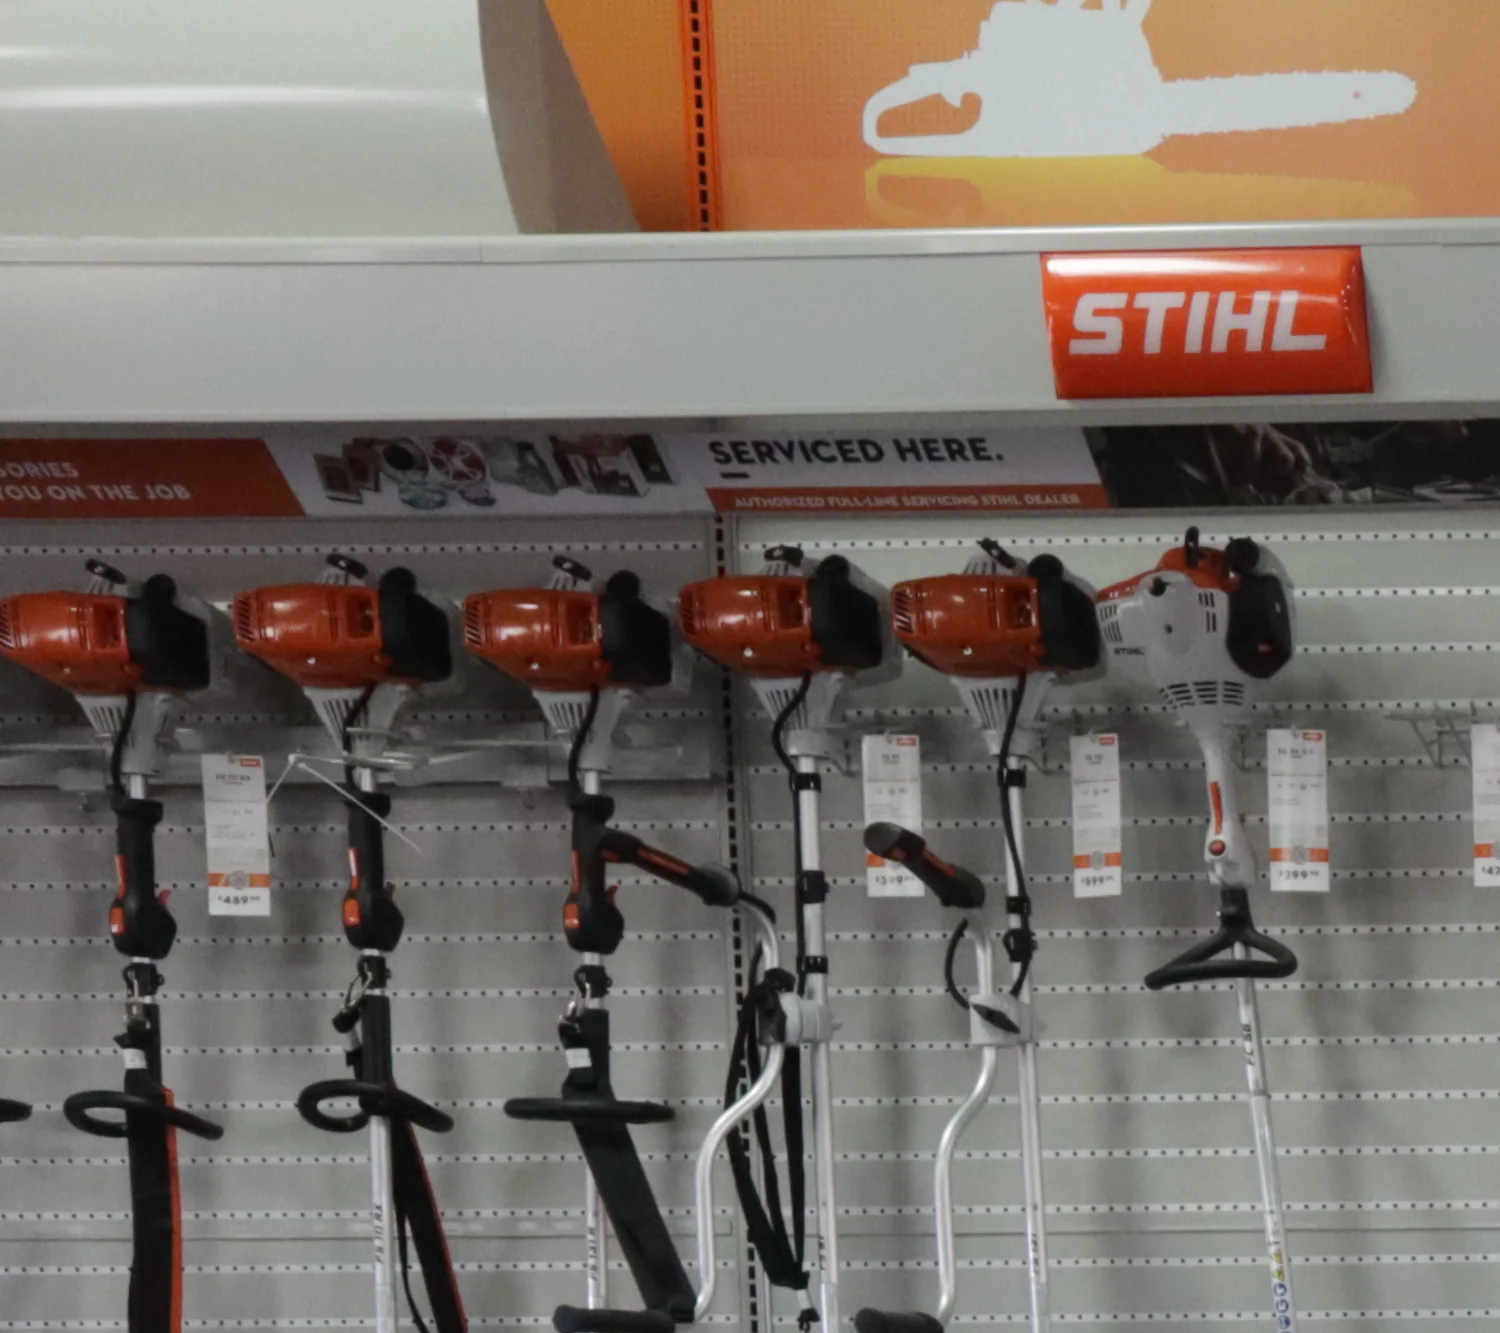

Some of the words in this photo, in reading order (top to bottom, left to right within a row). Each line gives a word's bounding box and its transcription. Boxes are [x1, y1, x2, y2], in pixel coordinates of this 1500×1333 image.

[1069, 290, 1328, 355] STIHL
[708, 438, 884, 465] SERVICED
[892, 436, 1005, 462] HERE.
[0, 484, 42, 501] OU
[47, 485, 87, 500] ON
[88, 484, 140, 500] THE
[147, 485, 192, 500] JOB
[734, 496, 825, 508] AUTHORIZED
[827, 495, 899, 507] FULL-LINE
[902, 495, 979, 507] SERVICING
[981, 494, 1023, 506] STIHL
[1025, 493, 1081, 505] DEALER
